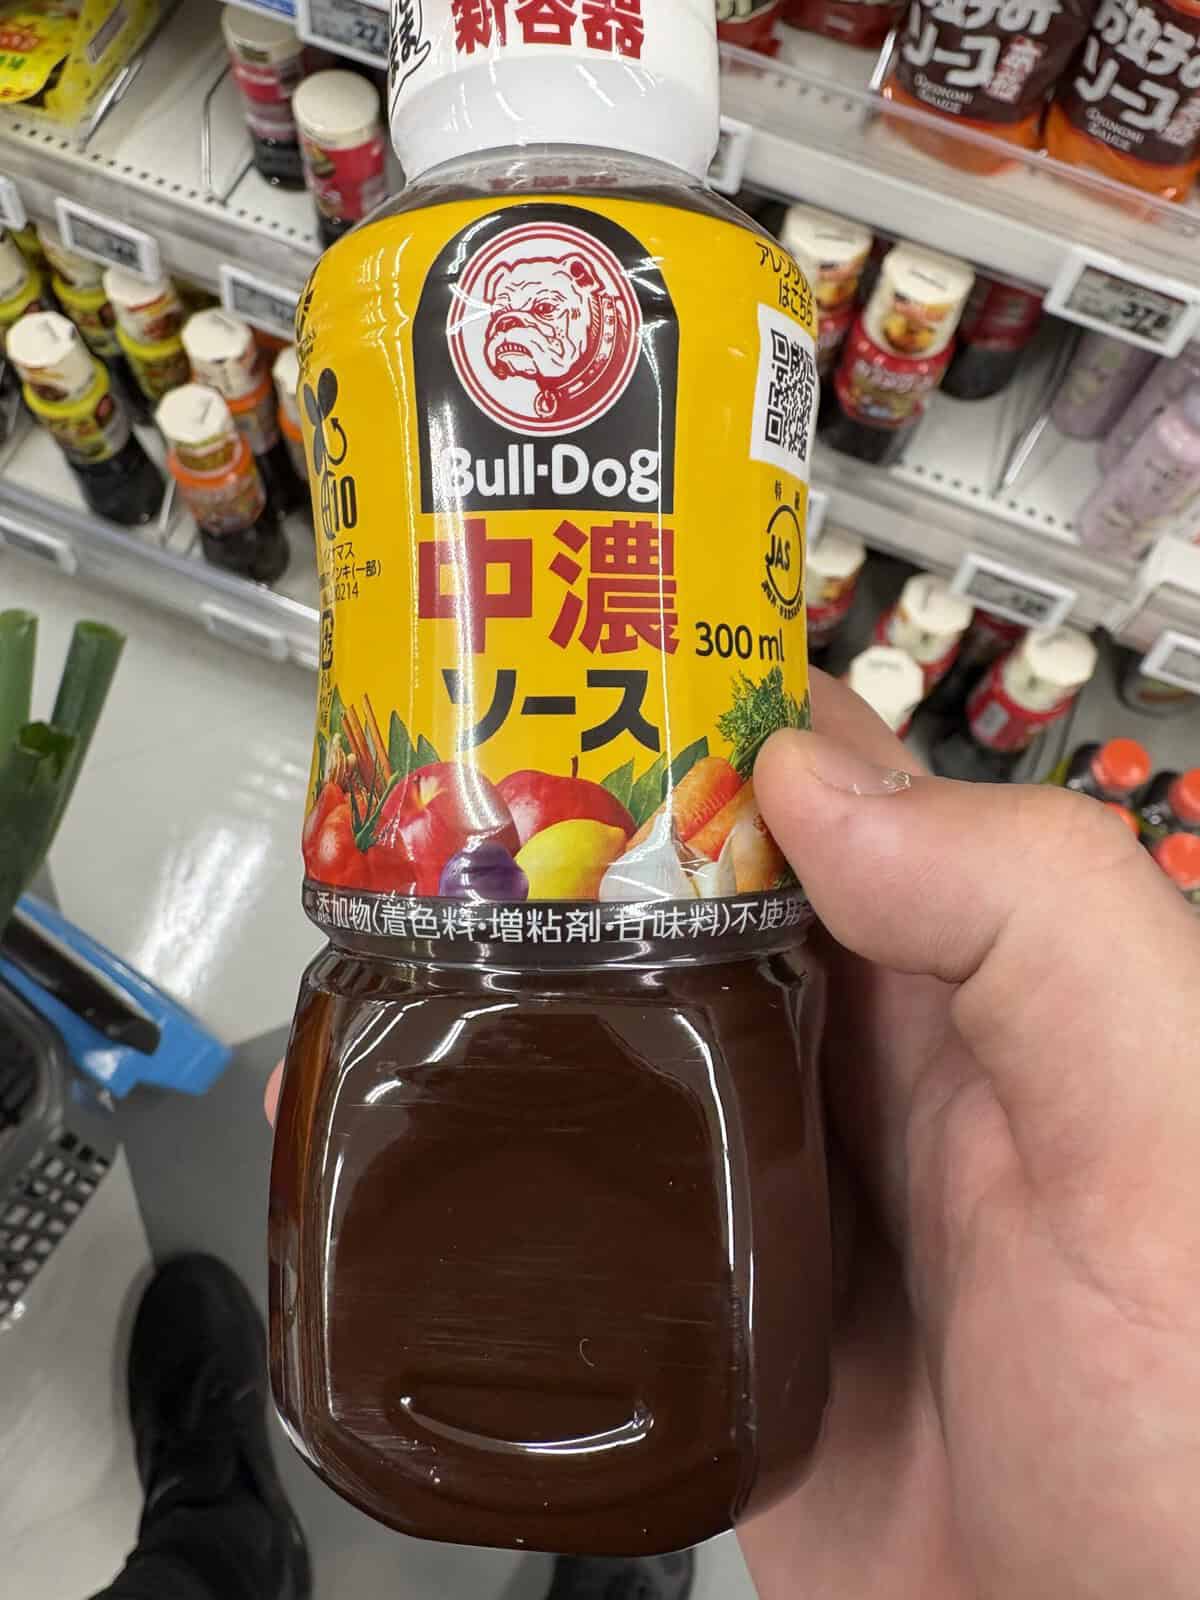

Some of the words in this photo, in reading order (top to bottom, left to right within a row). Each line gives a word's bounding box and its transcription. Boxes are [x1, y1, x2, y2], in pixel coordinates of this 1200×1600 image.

[440, 443, 660, 502] Bull-Dog
[418, 518, 680, 655] 中濃
[765, 533, 791, 571] JAS
[441, 668, 661, 753] ソース
